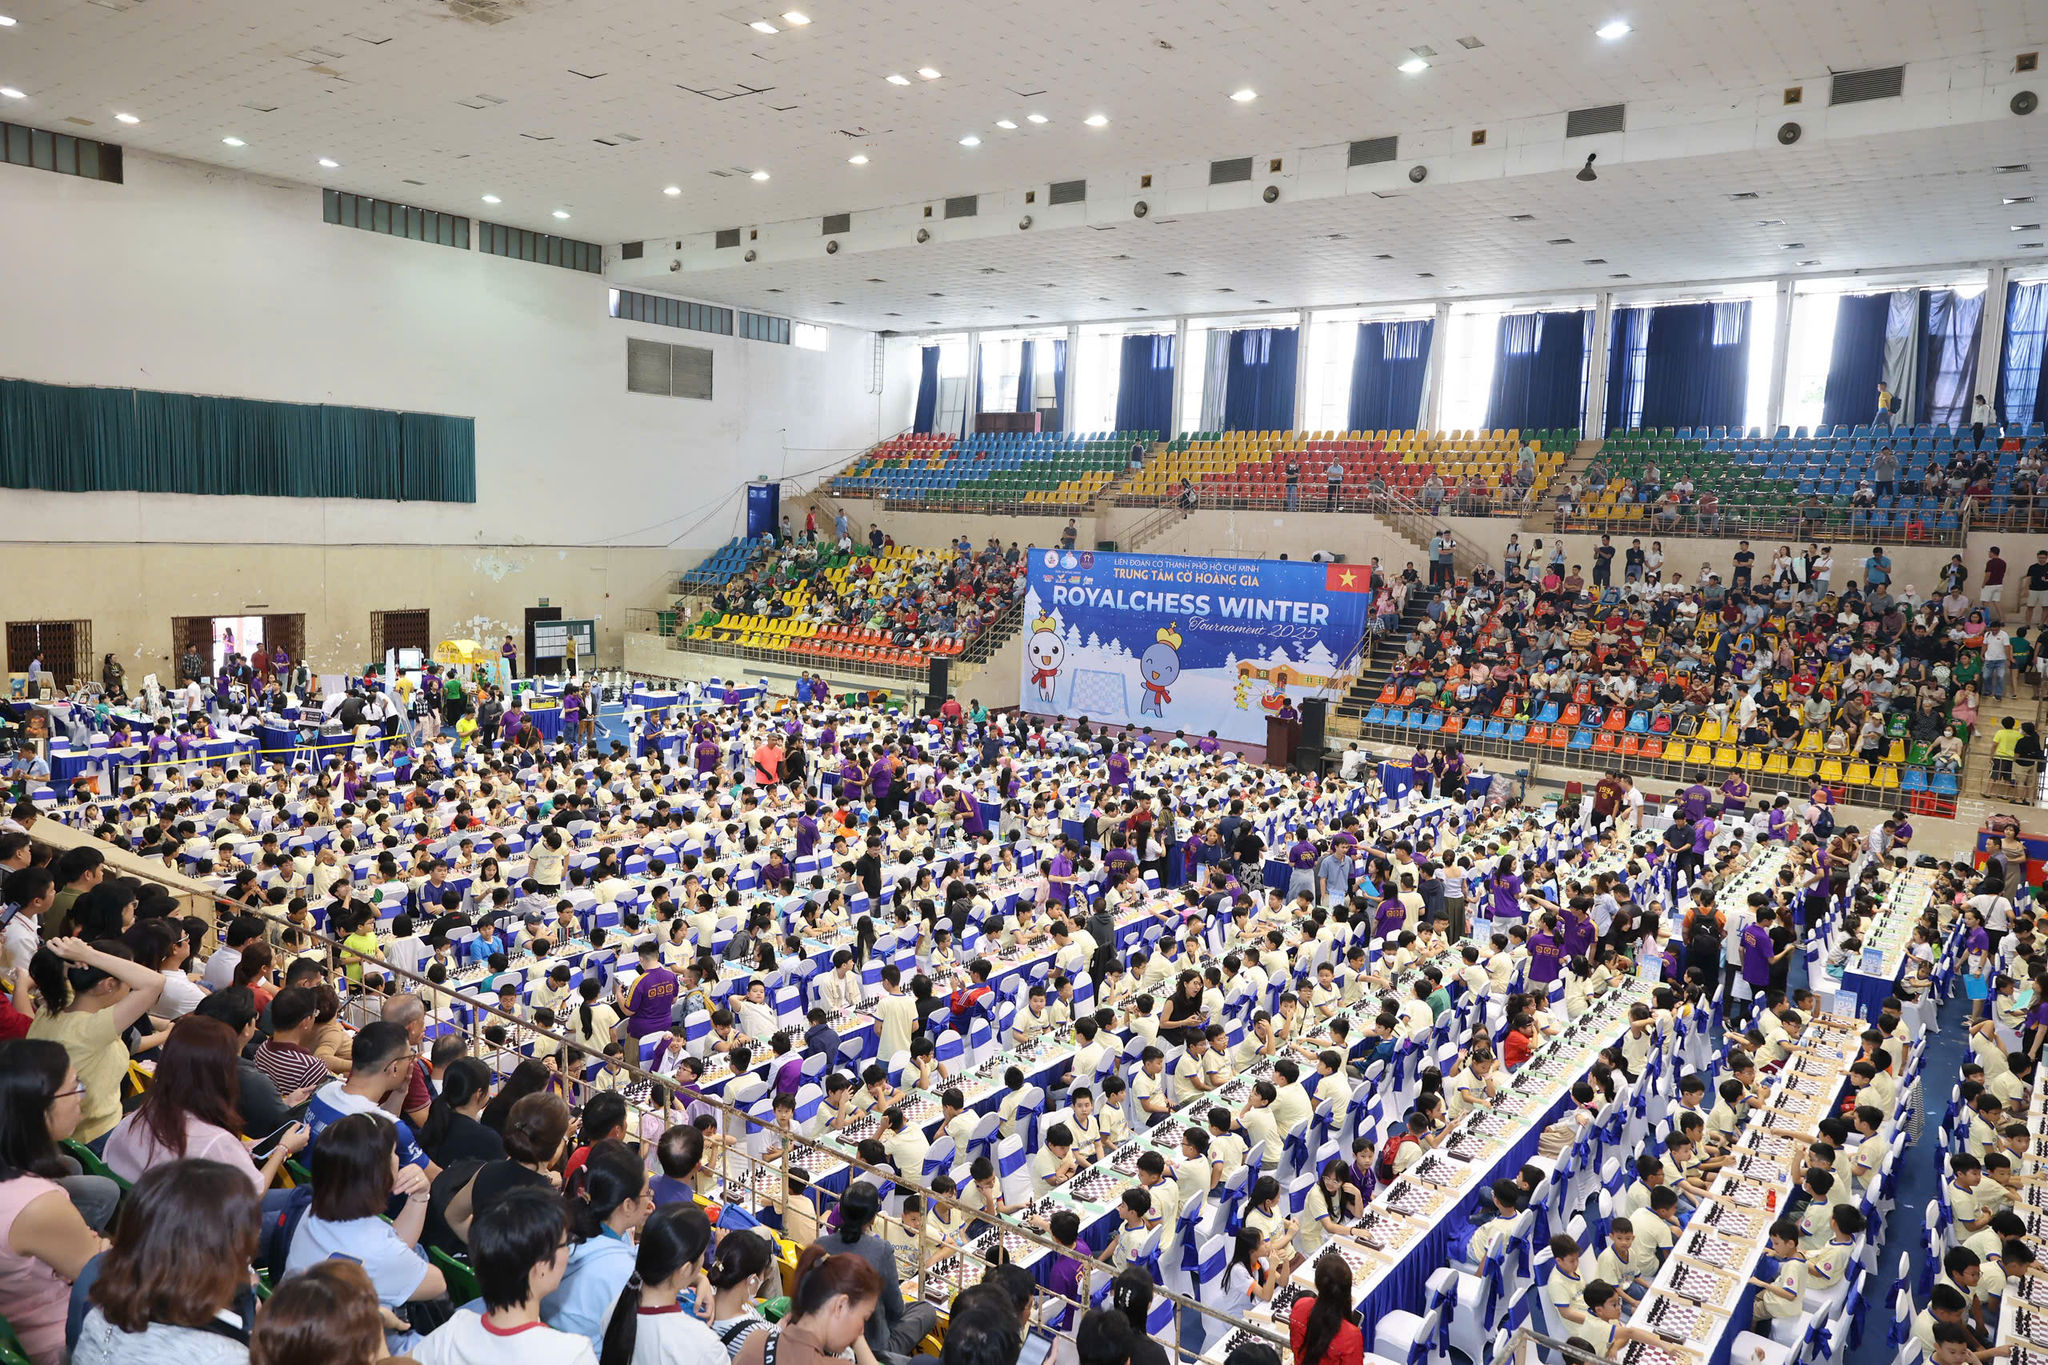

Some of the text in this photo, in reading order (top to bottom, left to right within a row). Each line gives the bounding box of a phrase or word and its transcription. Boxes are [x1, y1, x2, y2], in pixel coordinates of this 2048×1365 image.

[1114, 567, 1260, 587] TRUNG TÂM CỜ HOÀNG GIA
[1238, 564, 1260, 573] MINH
[1053, 585, 1330, 626] ROYALCHESS WINTER
[1188, 615, 1321, 640] Tournament 2025
